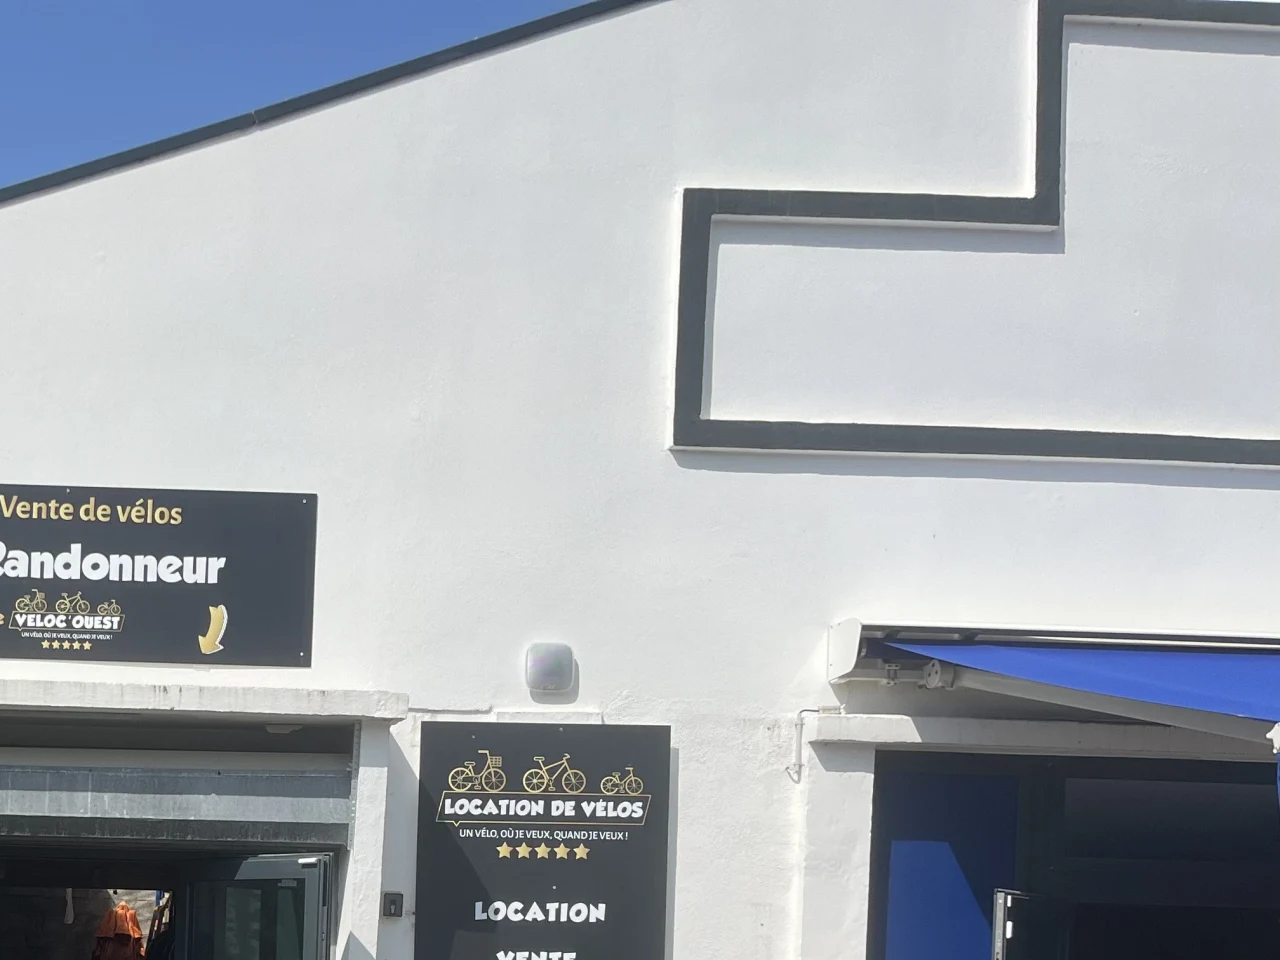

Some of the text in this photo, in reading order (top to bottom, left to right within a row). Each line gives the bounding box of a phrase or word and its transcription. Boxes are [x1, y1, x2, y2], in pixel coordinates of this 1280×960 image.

[0, 494, 74, 520] Vente
[79, 497, 111, 522] de
[116, 498, 183, 525] vélos
[444, 798, 644, 818] LOCATION DE VÉLOS
[459, 828, 473, 838] UN
[474, 826, 499, 839] VÉLO,
[500, 827, 514, 838] OÙ
[515, 829, 524, 840] JE
[525, 830, 553, 840] VEUX,
[554, 830, 587, 841] QUAND
[588, 831, 599, 841] JE
[599, 831, 623, 841] VEUX
[475, 901, 606, 922] LOCATION
